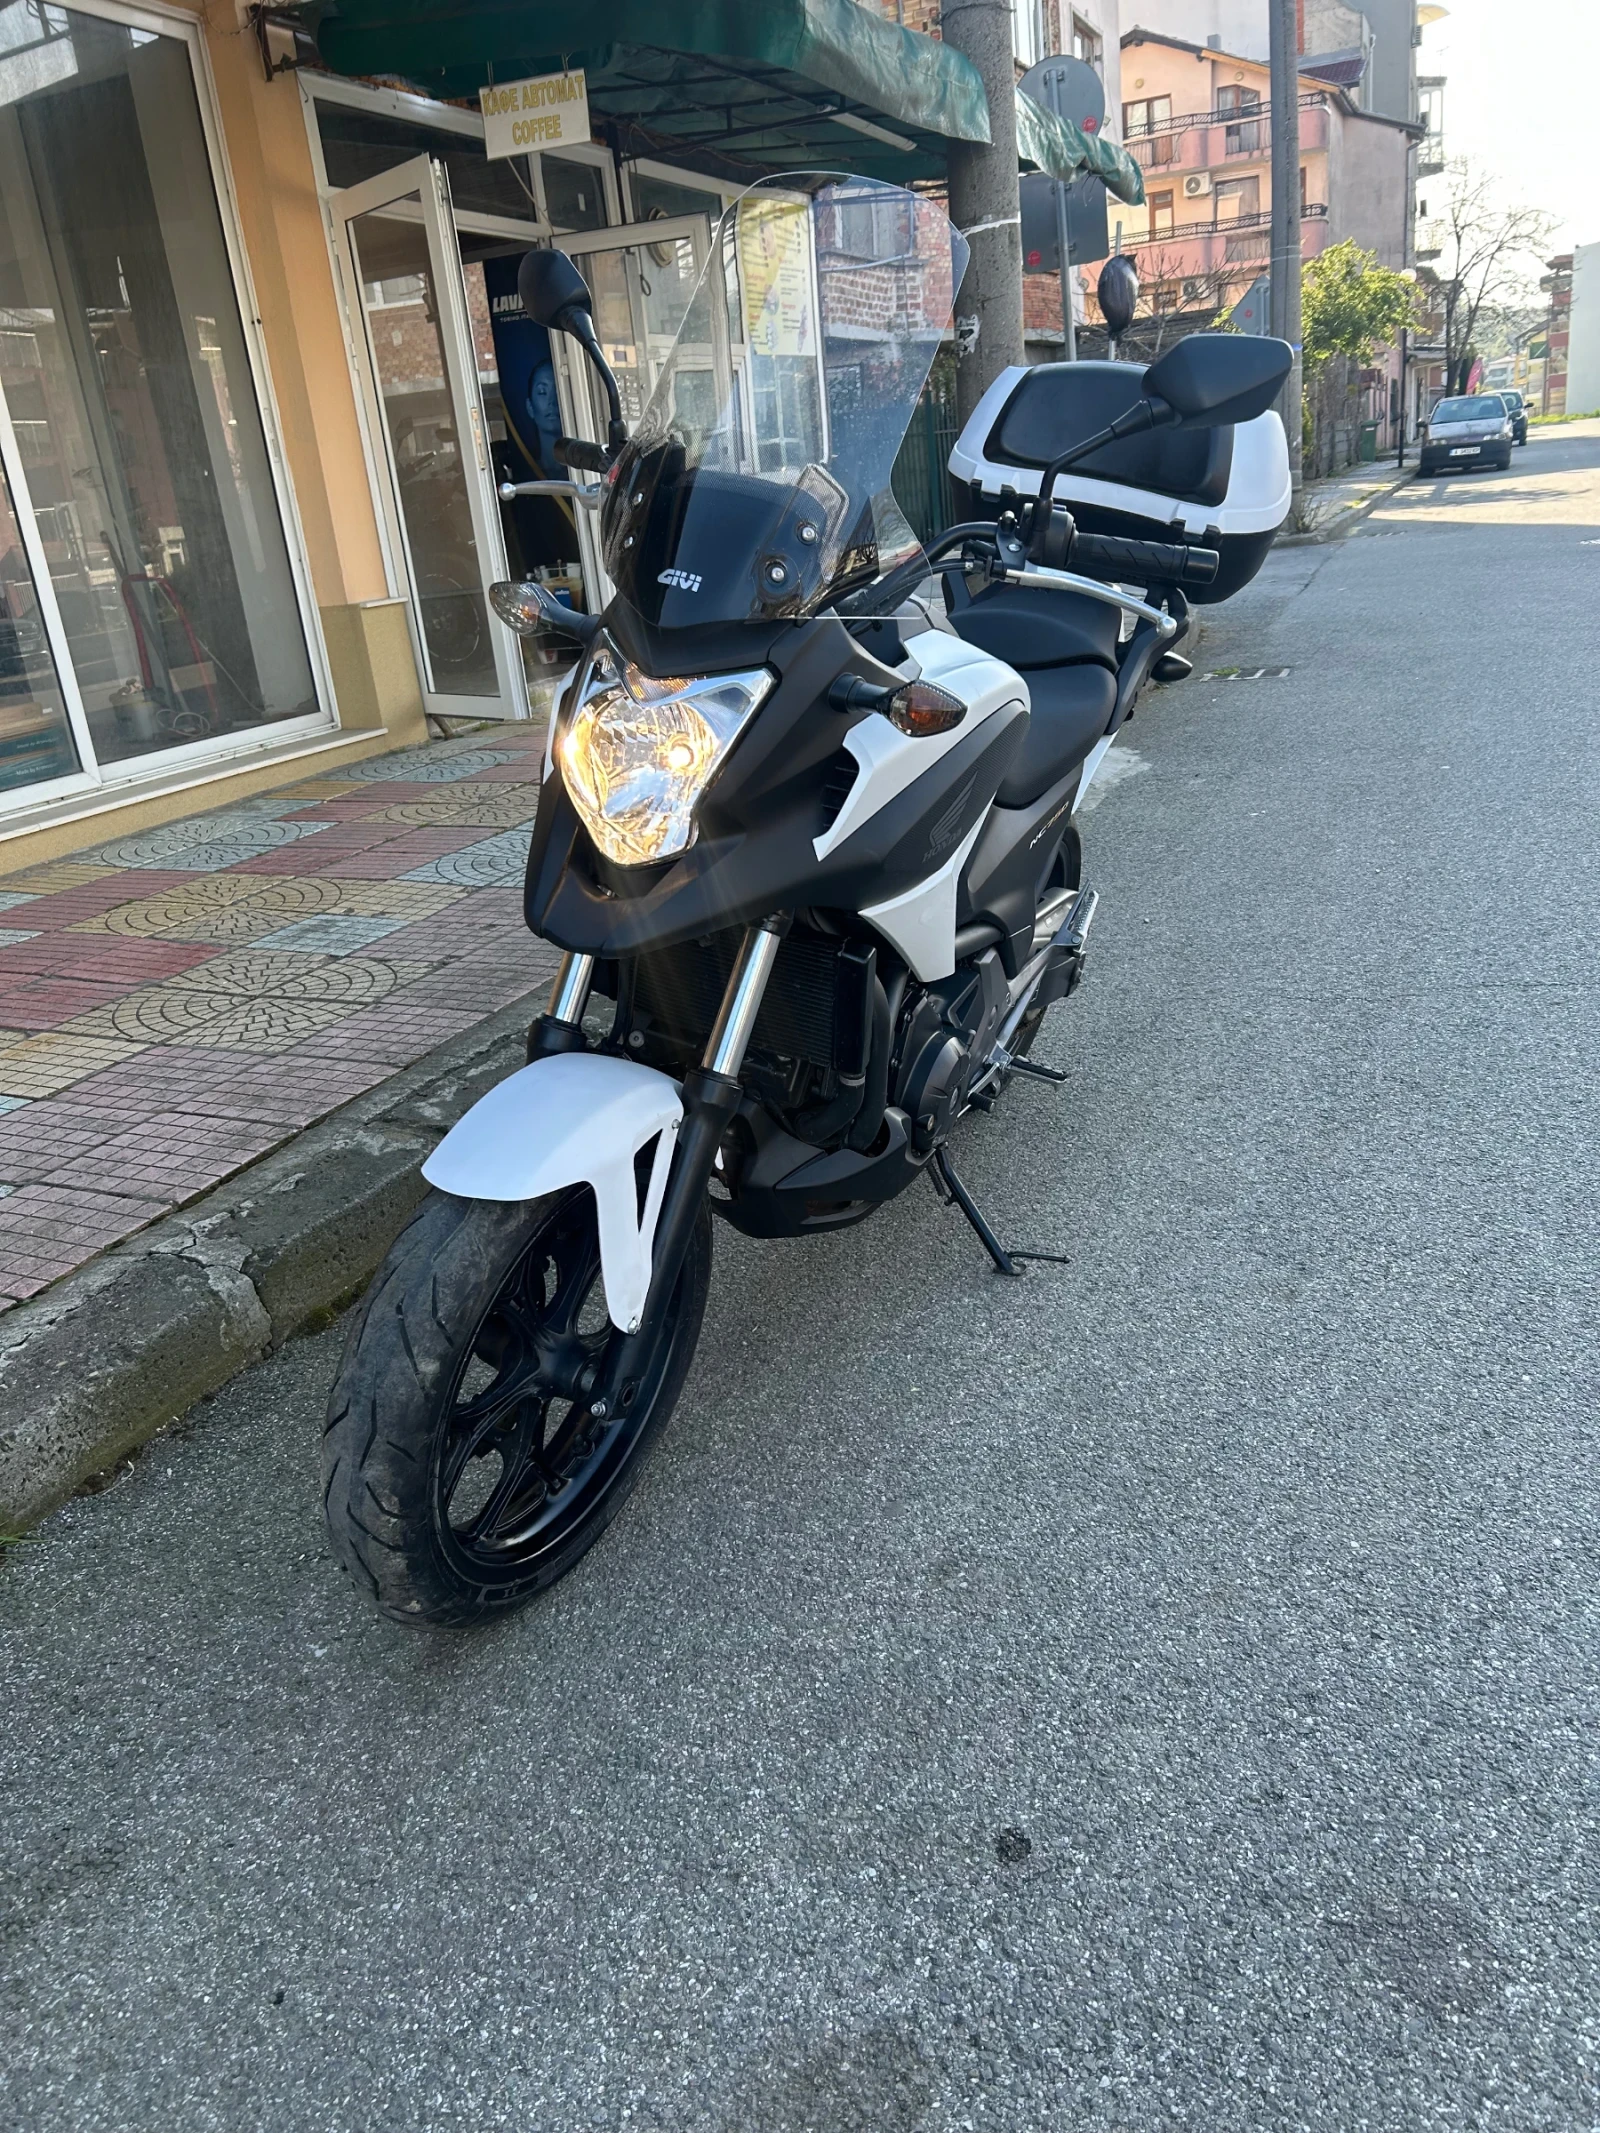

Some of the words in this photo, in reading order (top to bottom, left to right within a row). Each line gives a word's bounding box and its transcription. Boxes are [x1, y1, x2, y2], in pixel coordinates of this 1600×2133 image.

[482, 87, 520, 117] КАФЕ
[522, 75, 584, 110] АВТОМАТ
[512, 114, 563, 146] COFFEE
[657, 568, 703, 593] GIVI
